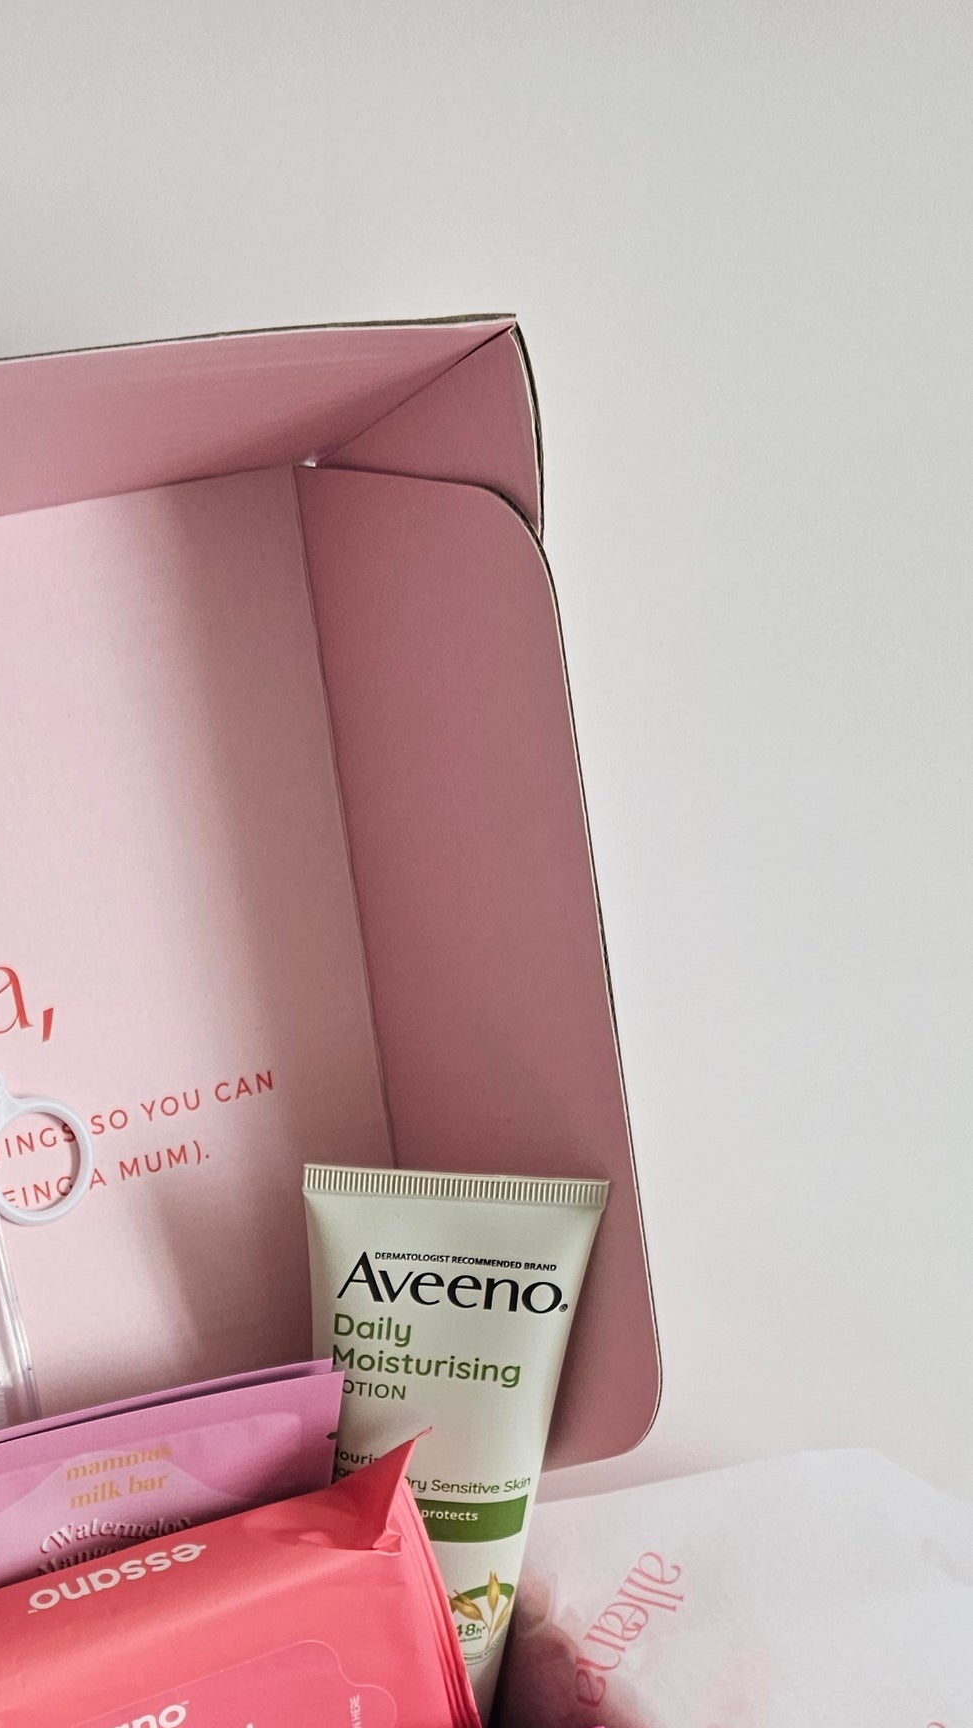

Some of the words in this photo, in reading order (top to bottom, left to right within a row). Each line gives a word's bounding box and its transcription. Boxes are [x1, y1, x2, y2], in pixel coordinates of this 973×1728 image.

[90, 1109, 128, 1135] SO
[140, 1089, 201, 1122] YOU
[214, 1070, 274, 1103] CAN
[2, 1175, 74, 1212] EING
[89, 1168, 107, 1190] A
[119, 1140, 211, 1182] MUM).
[374, 1252, 450, 1264] DERMATOLOGIST
[451, 1255, 522, 1270] RECOMMENDED
[524, 1262, 557, 1272] BRAND
[334, 1312, 412, 1348] Daily
[332, 1344, 521, 1388] Moisturising
[342, 1378, 407, 1400] OTION
[64, 1441, 174, 1483] mammas
[69, 1479, 125, 1511] milk
[128, 1471, 169, 1498] bar
[431, 1476, 500, 1495] Sensitive
[503, 1475, 531, 1494] Skin
[40, 1514, 191, 1555] Watermelon
[421, 1508, 479, 1523] protects
[349, 1694, 361, 1721] HERE
